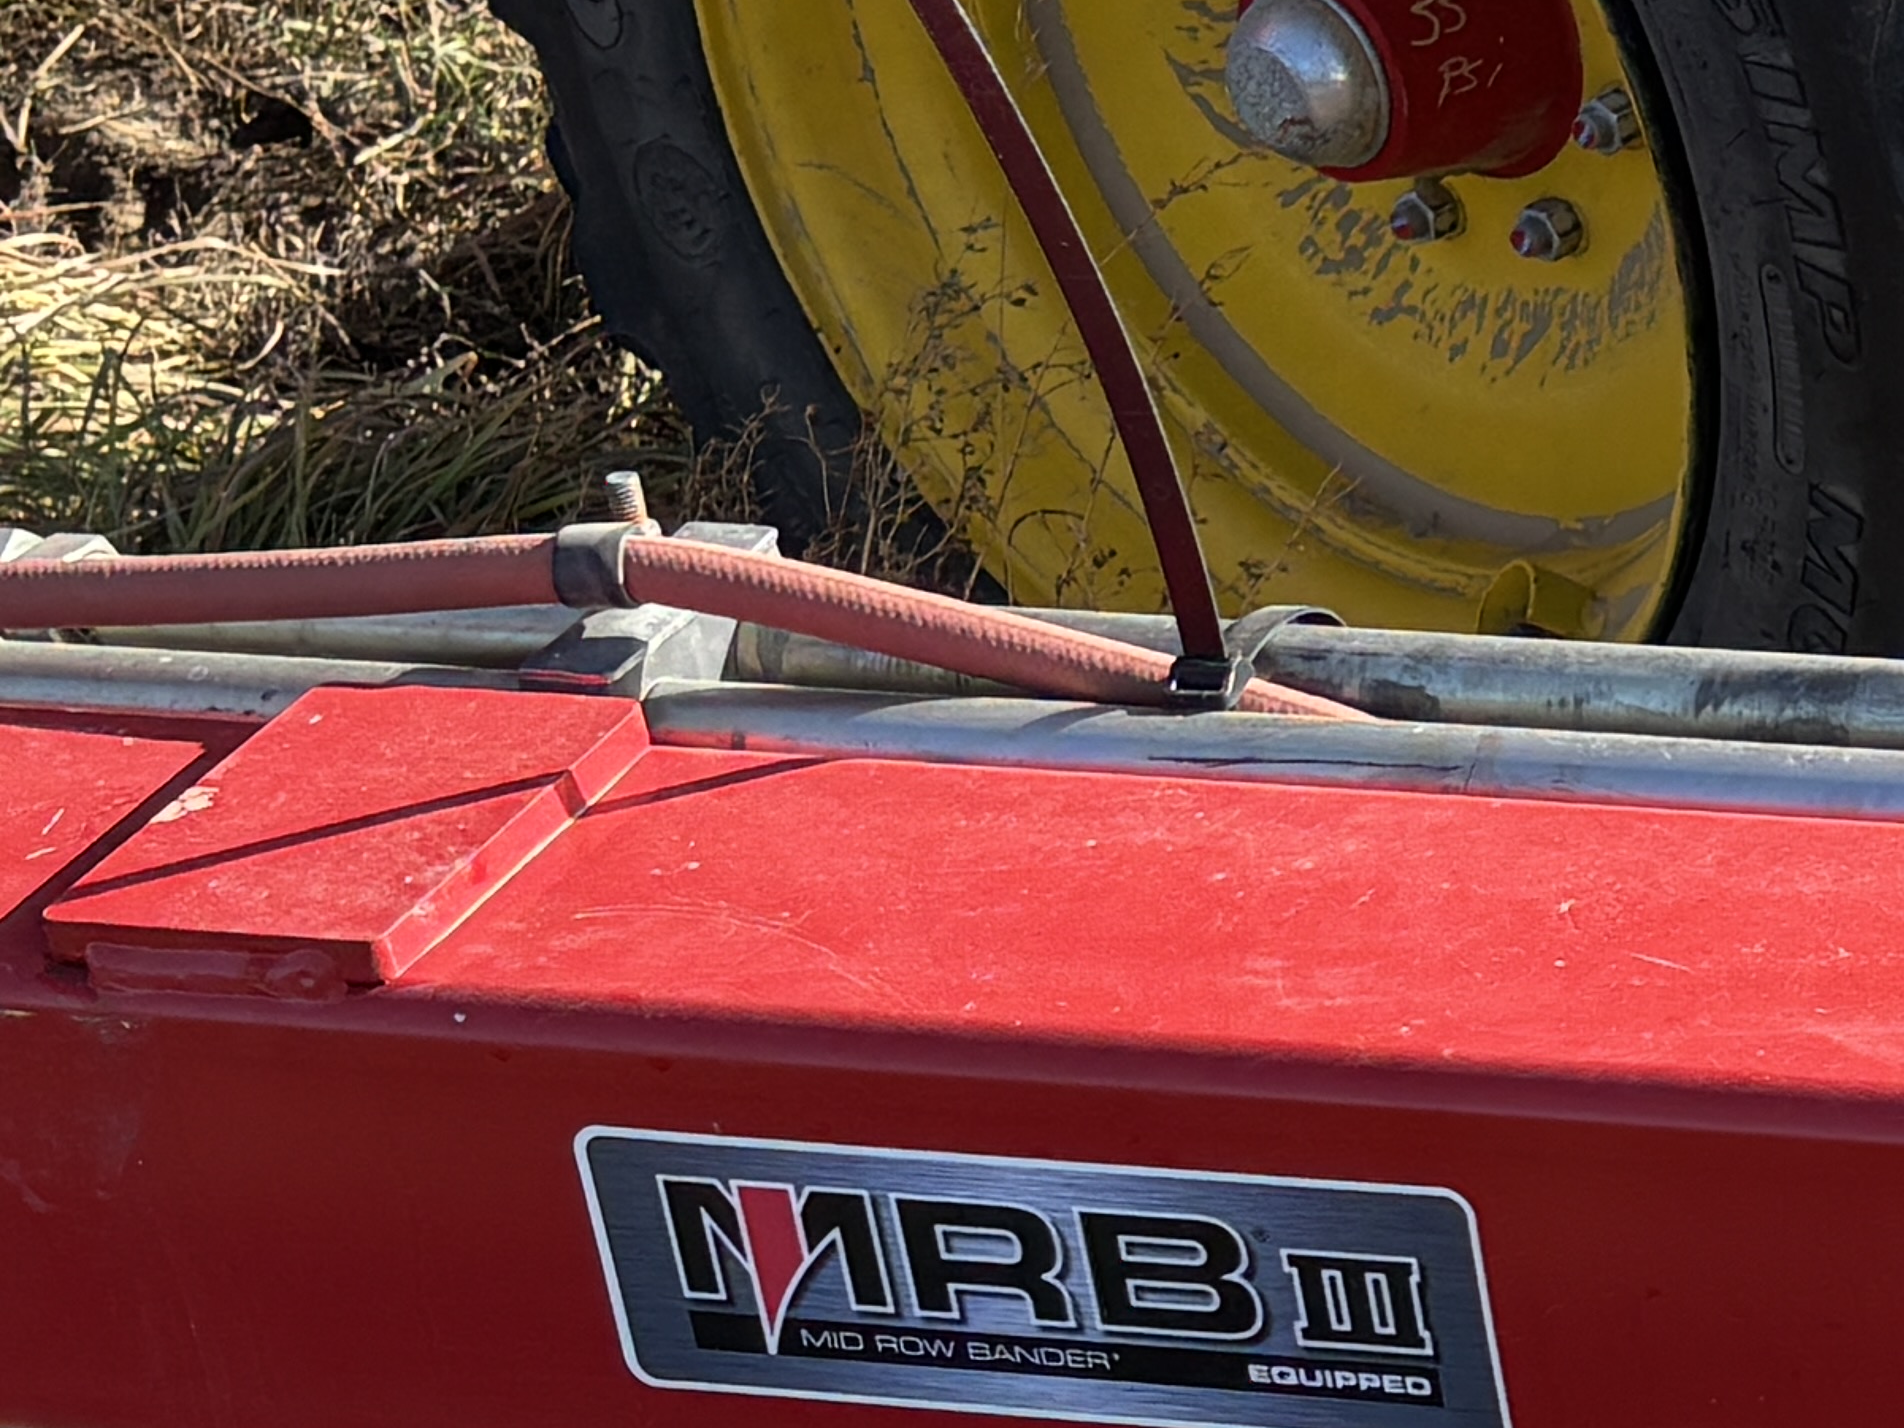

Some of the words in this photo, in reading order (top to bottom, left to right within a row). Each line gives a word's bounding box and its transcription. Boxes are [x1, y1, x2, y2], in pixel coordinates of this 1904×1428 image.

[655, 1174, 1264, 1356] MRB
[1279, 1247, 1434, 1356] III
[800, 1328, 864, 1351] MID
[875, 1334, 955, 1359] ROW
[1247, 1363, 1433, 1396] EQUIPPED
